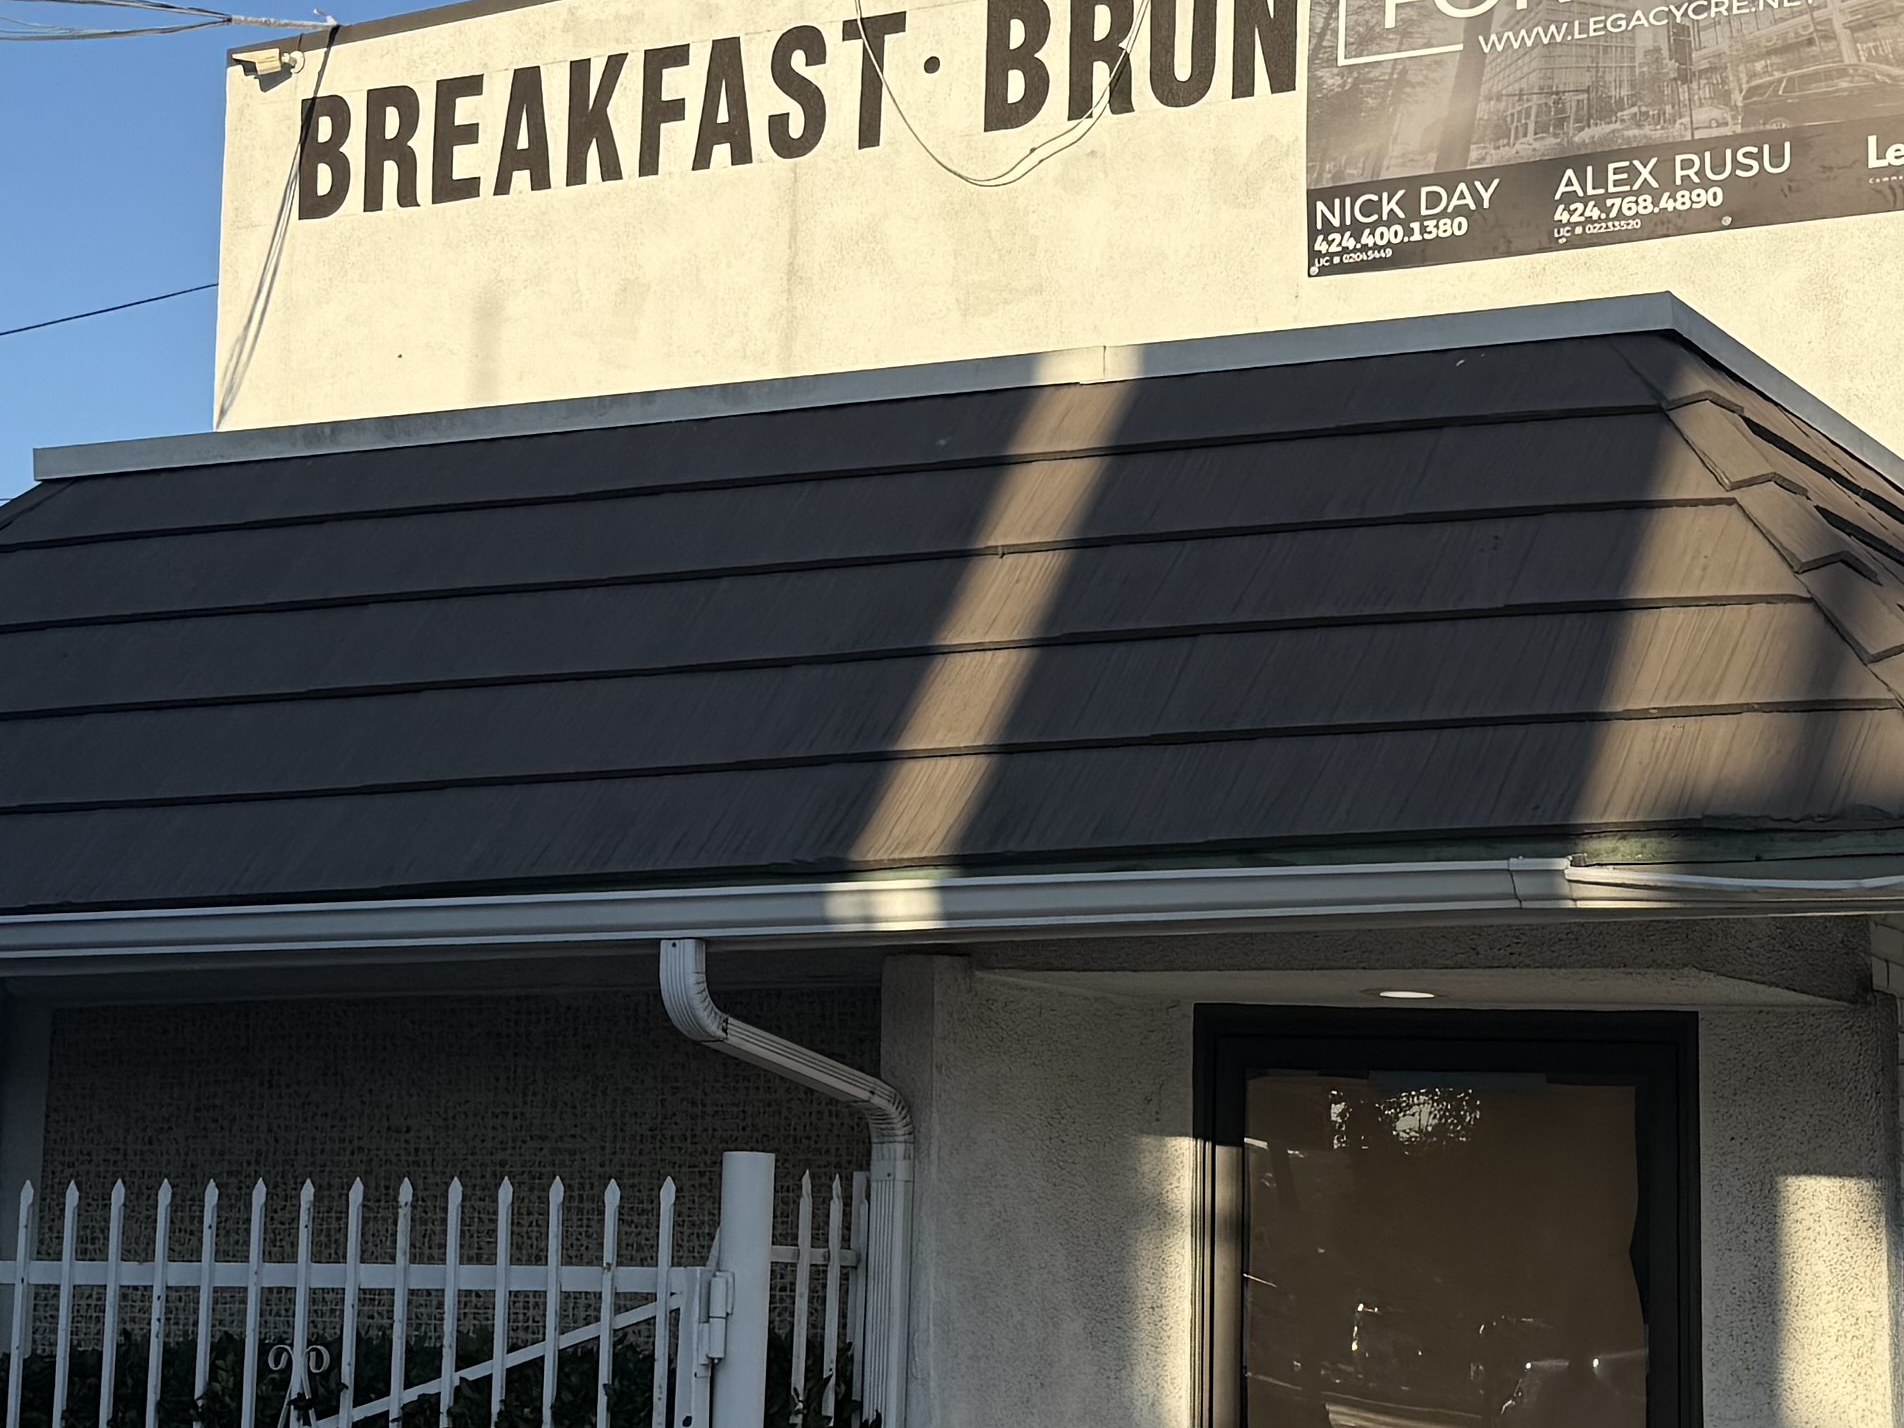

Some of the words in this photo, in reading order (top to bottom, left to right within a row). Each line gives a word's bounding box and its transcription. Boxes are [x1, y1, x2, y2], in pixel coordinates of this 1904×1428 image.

[298, 11, 906, 221] BREAKFAST
[1554, 157, 1660, 201] ALEX
[1675, 141, 1792, 186] RUSU
[1316, 189, 1406, 230] NICK
[1420, 178, 1501, 216] DAY
[1554, 186, 1724, 224] 424.768.4890
[1314, 216, 1469, 254] 424.400.1380
